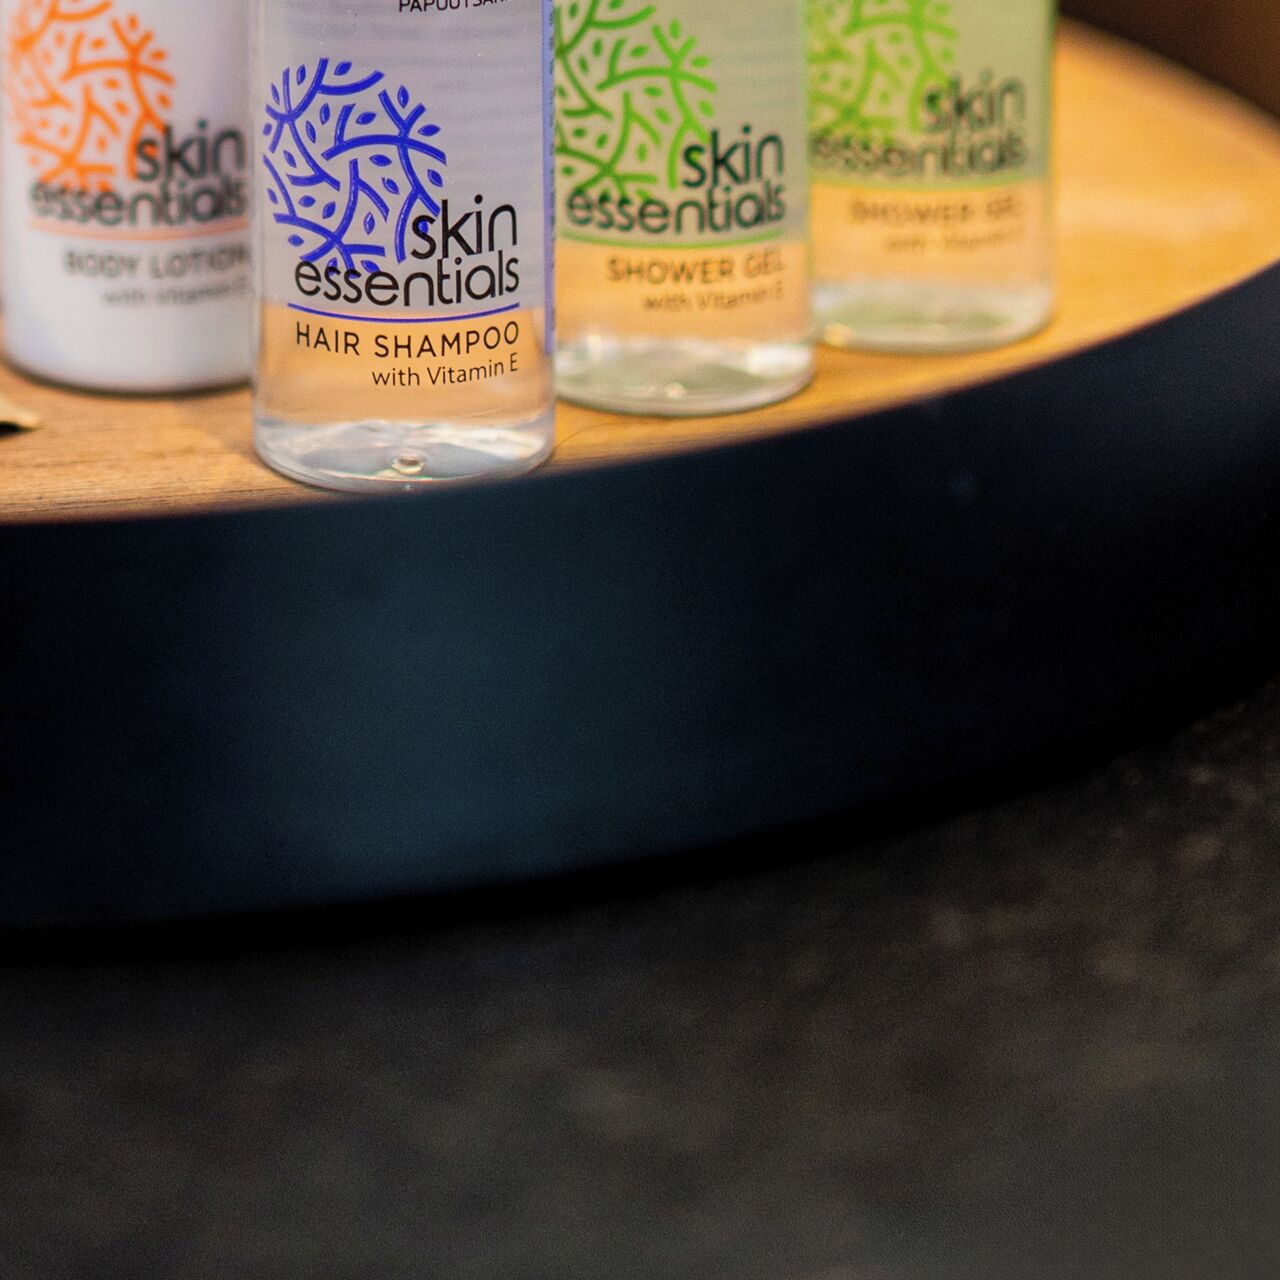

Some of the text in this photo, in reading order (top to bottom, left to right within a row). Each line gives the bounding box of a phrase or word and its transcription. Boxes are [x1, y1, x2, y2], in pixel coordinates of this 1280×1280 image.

[925, 69, 1025, 133] skin
[136, 120, 244, 183] skin
[682, 124, 784, 189] skin
[32, 177, 247, 227] essentials
[411, 195, 518, 261] skin
[568, 181, 785, 234] essentials
[66, 250, 141, 278] BODY
[295, 251, 519, 307] essentials
[607, 248, 784, 284] SHOWER GEL
[296, 321, 519, 358] HAIR SHAMPOO
[372, 353, 519, 387] with Vitamin E
